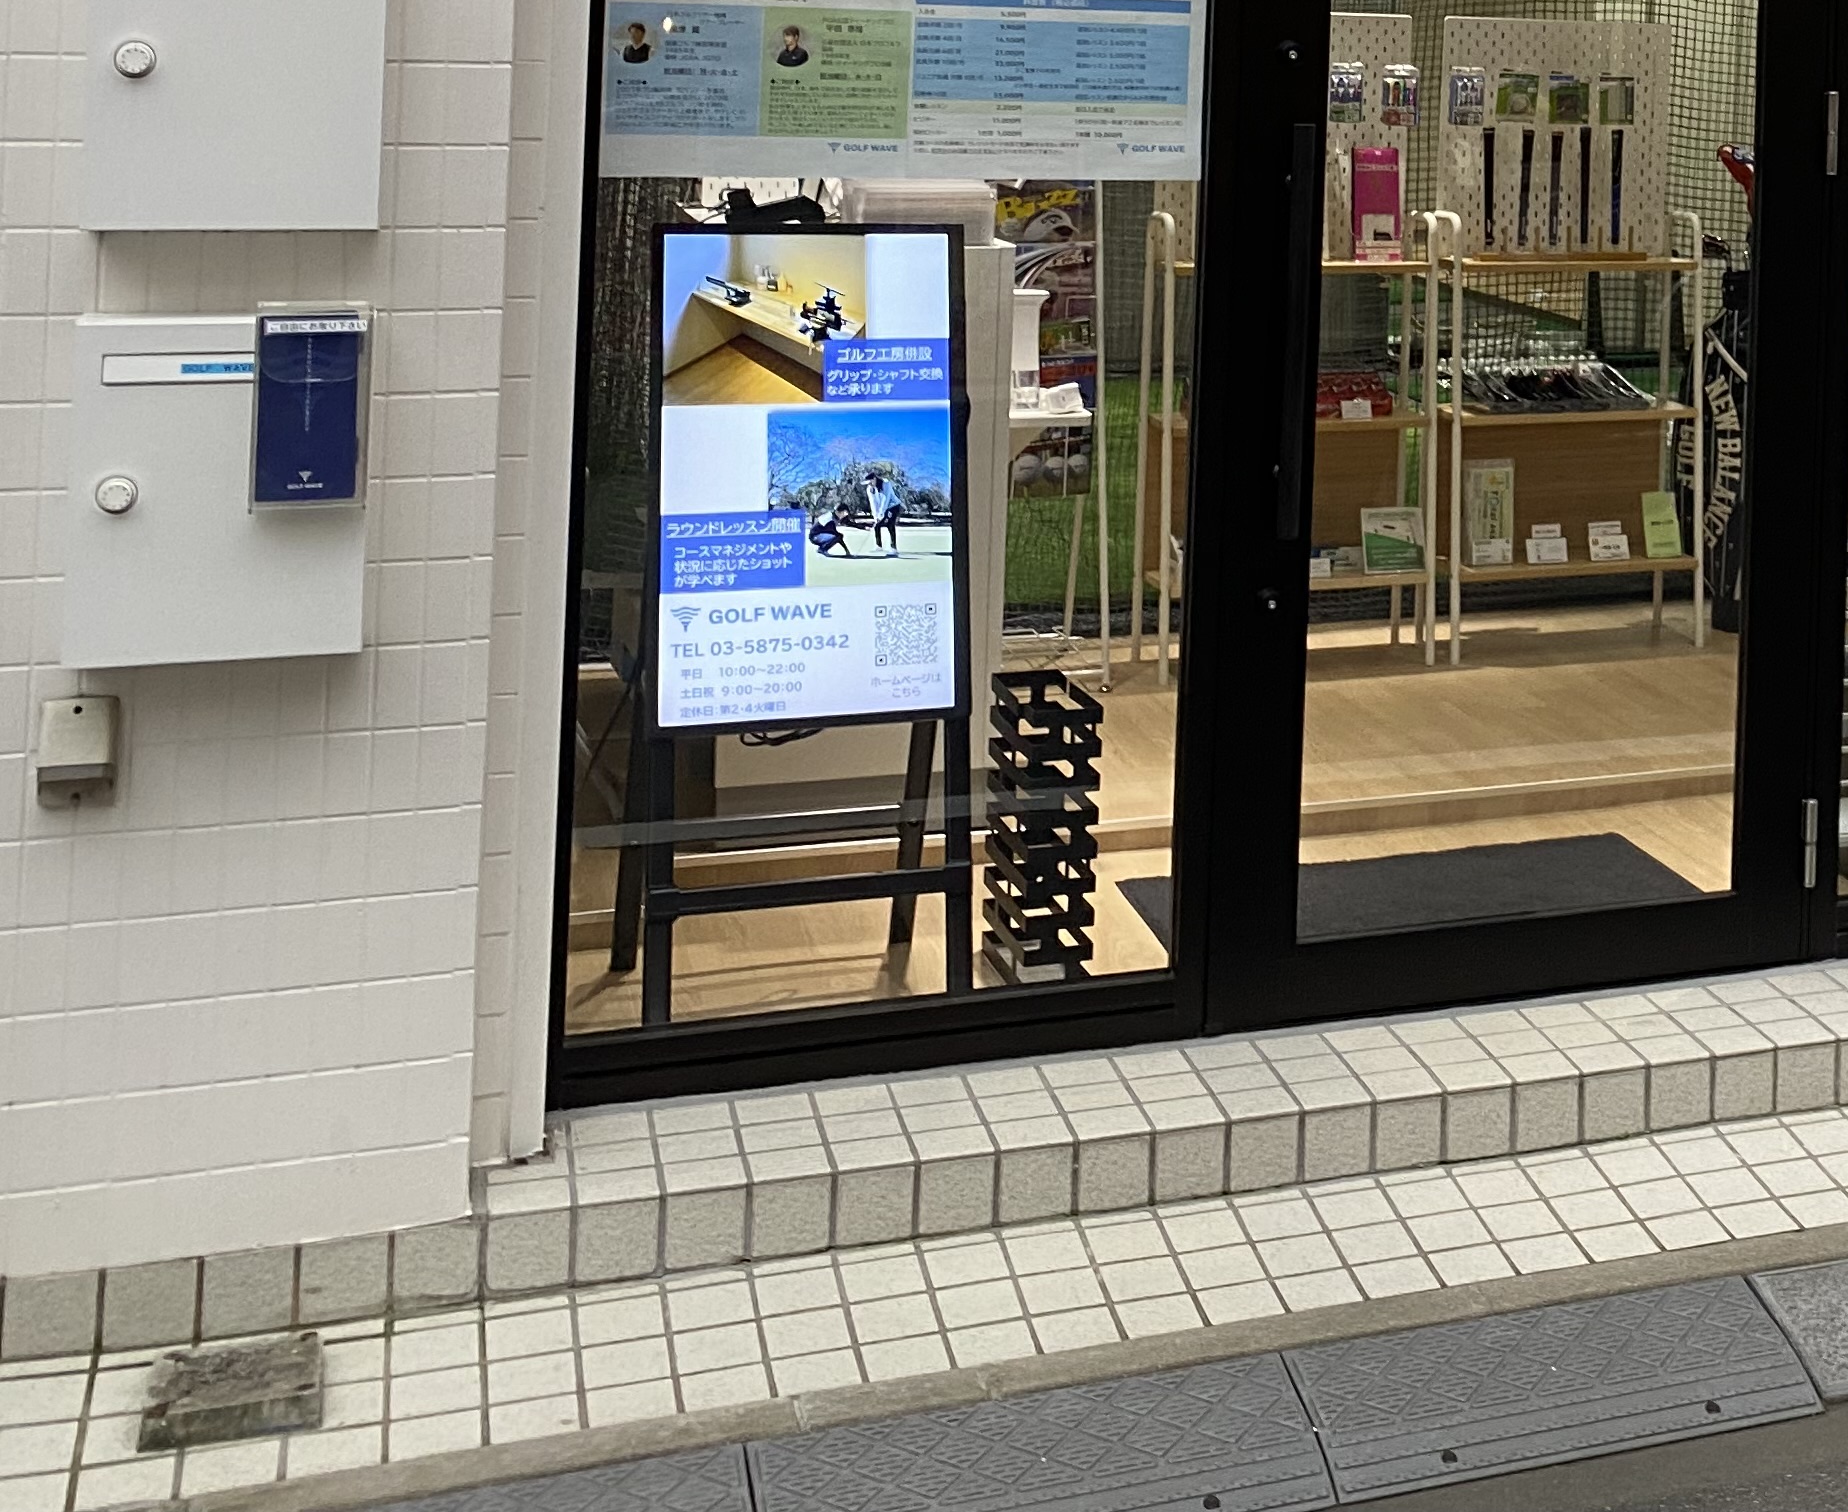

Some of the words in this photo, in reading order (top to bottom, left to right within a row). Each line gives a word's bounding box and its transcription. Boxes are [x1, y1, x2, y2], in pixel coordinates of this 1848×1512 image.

[843, 144, 868, 153] GOLF
[870, 144, 899, 153] WAVE
[1131, 144, 1157, 153] GOLF
[1158, 144, 1186, 153] WAVE
[270, 320, 367, 332] ご自由にお取り下さい
[837, 346, 932, 362] ゴルフ工房併設
[827, 367, 944, 382] グリップ・シャフト交換
[826, 383, 894, 397] など承ります
[1704, 374, 1741, 431] NEW
[1702, 437, 1743, 550] BALANCE
[666, 517, 801, 538] ラウンドレッスン開催
[674, 541, 793, 559] コースマネジメントや
[674, 556, 793, 574] 状況に応じたショット
[674, 573, 738, 588] が学べます
[709, 607, 766, 625] GOLF
[770, 603, 832, 621] WAVE
[670, 643, 705, 659] TEL
[710, 634, 850, 657] 03-5875-0342
[680, 668, 703, 681] 平日
[871, 672, 942, 687] ホームページは
[680, 687, 715, 700] 土日祝
[892, 686, 921, 699] こちら
